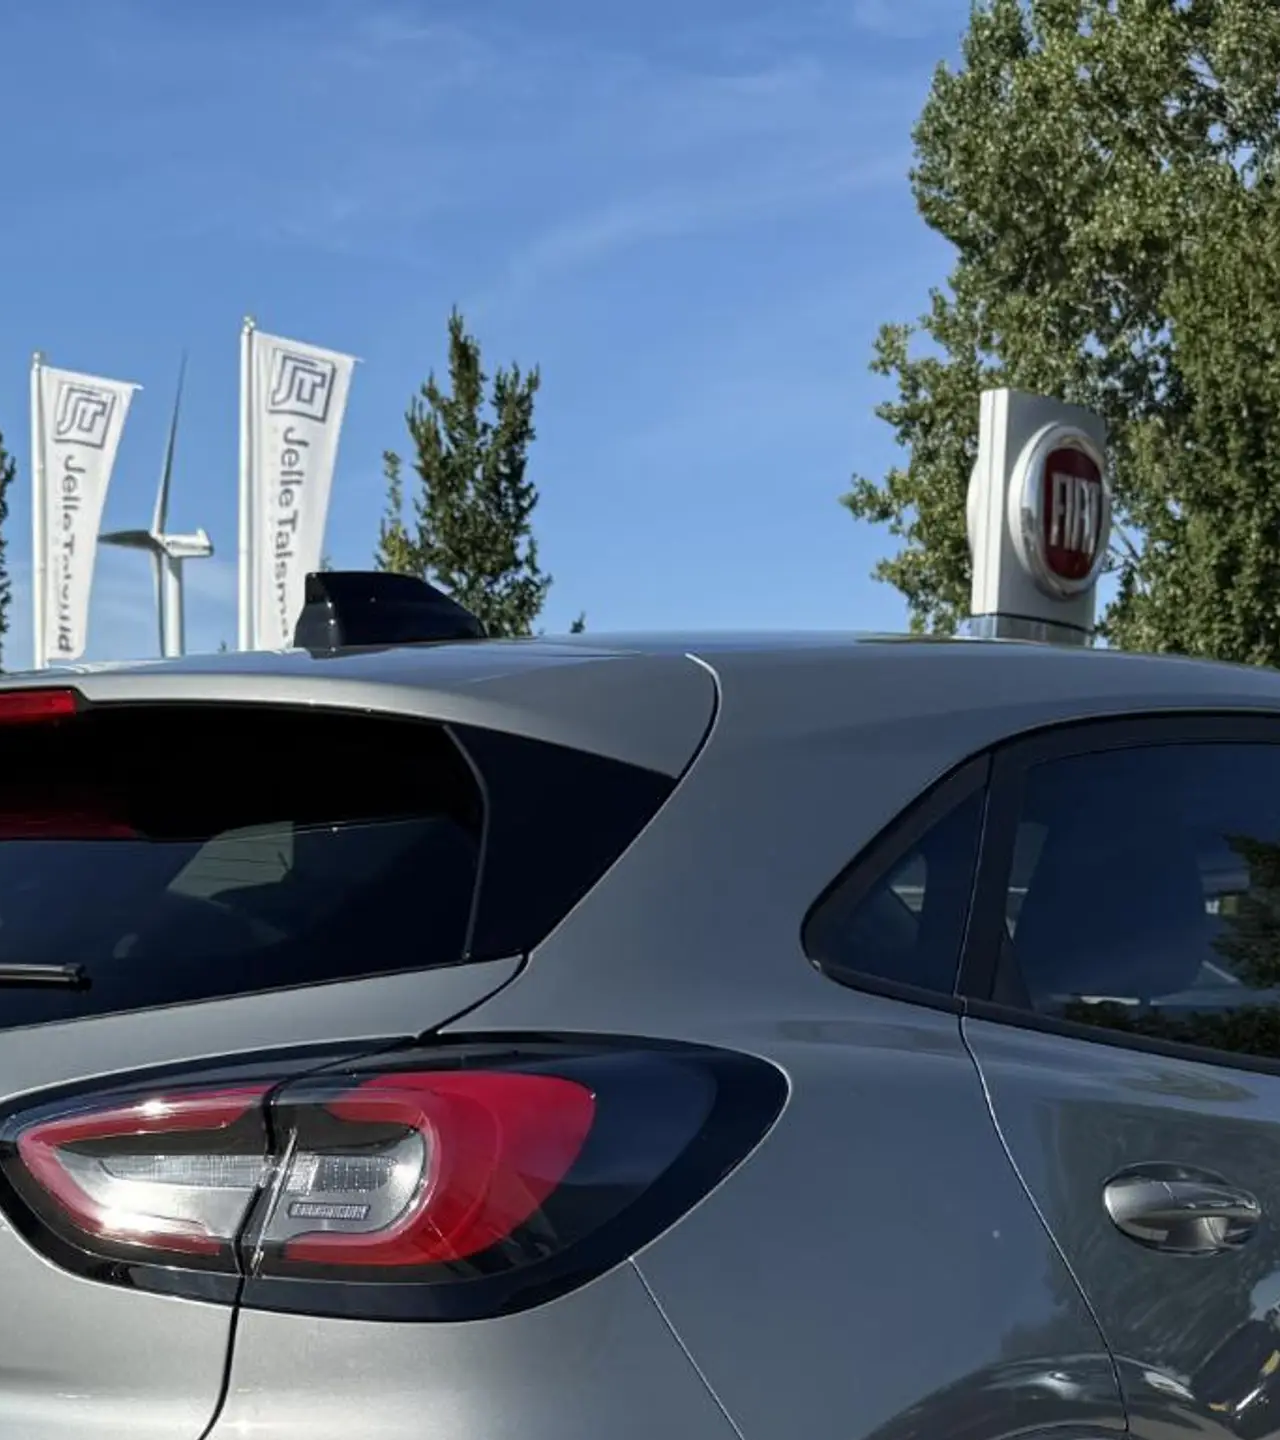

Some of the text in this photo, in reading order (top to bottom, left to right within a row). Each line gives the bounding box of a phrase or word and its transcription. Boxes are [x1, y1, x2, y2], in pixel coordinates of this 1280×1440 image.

[62, 454, 86, 532] Jelle
[279, 427, 310, 508] Jelle
[1049, 472, 1100, 555] FIAT
